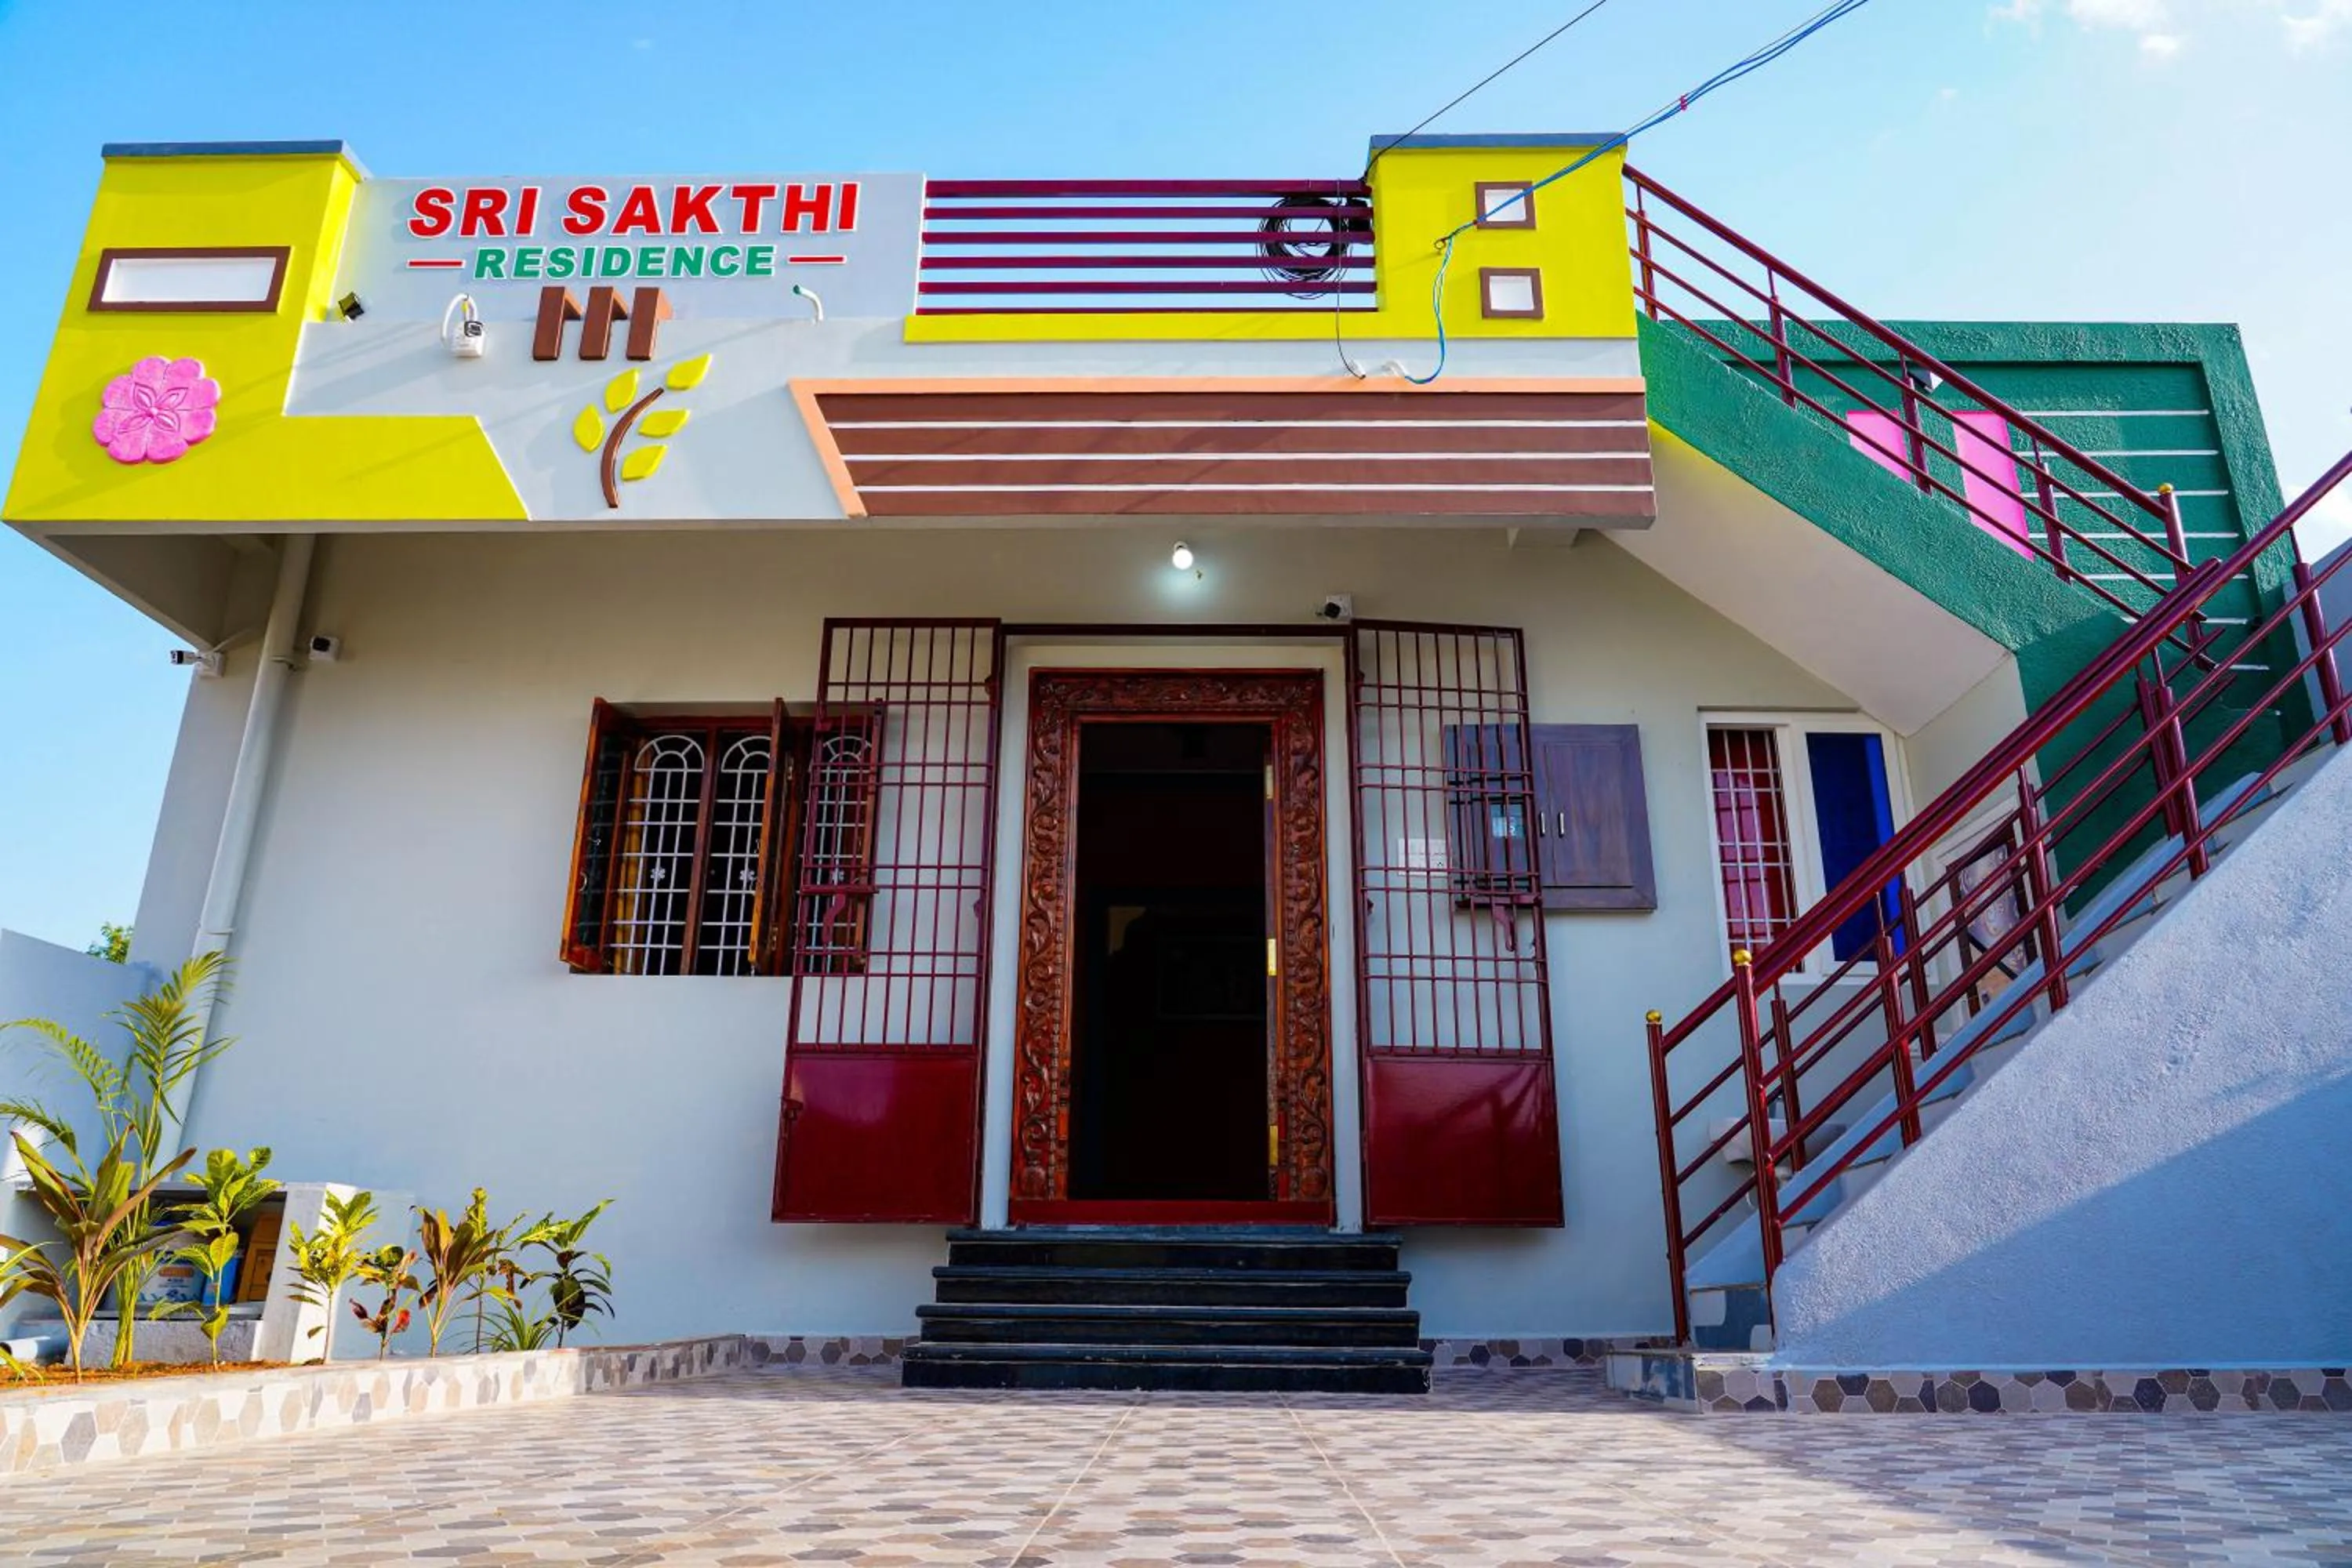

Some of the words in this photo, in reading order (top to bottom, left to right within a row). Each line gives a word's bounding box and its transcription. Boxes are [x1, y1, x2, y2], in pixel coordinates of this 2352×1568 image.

[408, 187, 539, 237] SRI
[562, 183, 859, 235] SAKTHI
[474, 245, 775, 278] RESIDENCE
